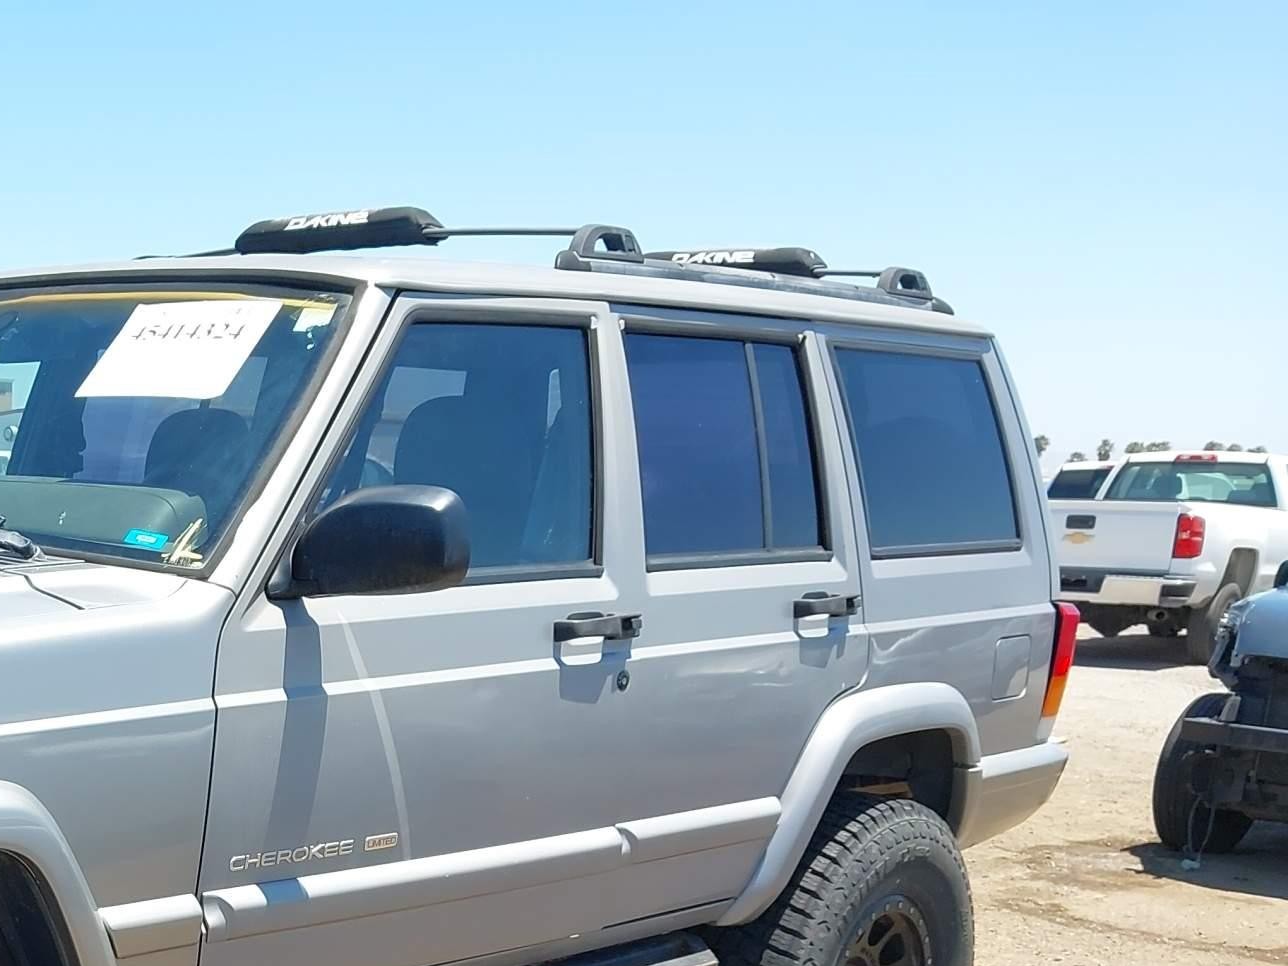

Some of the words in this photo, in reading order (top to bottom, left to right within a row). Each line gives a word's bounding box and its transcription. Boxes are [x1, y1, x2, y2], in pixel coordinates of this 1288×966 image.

[284, 211, 369, 231] DAKINE
[671, 250, 755, 265] DAKINE
[229, 839, 355, 872] CHEROKEE
